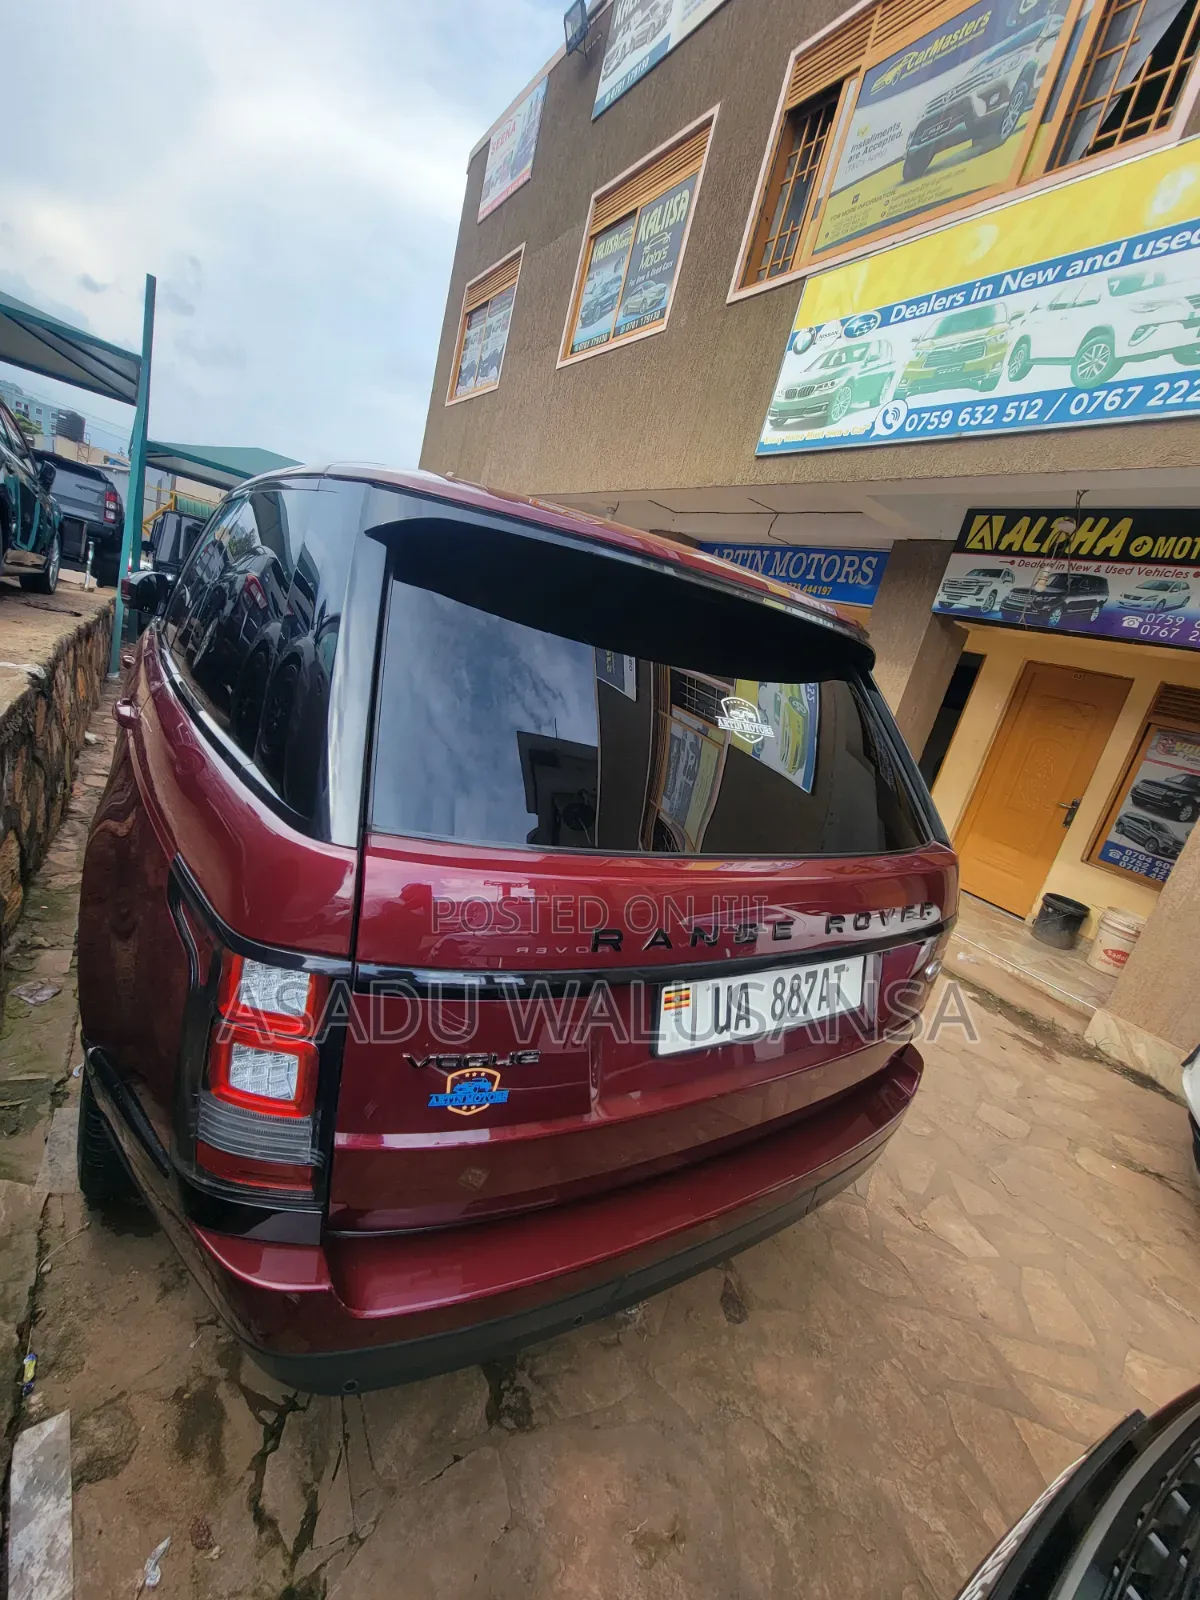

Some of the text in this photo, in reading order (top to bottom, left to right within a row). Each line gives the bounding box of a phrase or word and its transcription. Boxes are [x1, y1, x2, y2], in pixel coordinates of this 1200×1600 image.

[905, 10, 993, 71] CarMasters
[851, 122, 901, 153] Installments
[848, 151, 861, 164] are
[637, 189, 690, 245] KALIISA
[639, 246, 670, 272] Motors
[889, 289, 965, 324] Dealers
[970, 282, 994, 302] in
[1000, 265, 1063, 295] New
[1066, 241, 1126, 278] and
[905, 410, 953, 433] 0759
[956, 404, 998, 429] 632
[1002, 398, 1044, 424] 512
[1069, 385, 1145, 416] 0767
[998, 515, 1134, 558] ALPHA
[768, 551, 878, 587] MOTORS
[1055, 561, 1066, 571] in
[1068, 562, 1091, 573] New
[1093, 564, 1102, 574] &
[1104, 564, 1135, 576] Used
[1136, 566, 1190, 579] Vehicles
[803, 584, 833, 597] 444197
[1145, 612, 1185, 627] 0759
[1140, 624, 1181, 639] 0767
[1121, 855, 1150, 870] 0752
[1124, 849, 1153, 864] 0704
[1118, 861, 1147, 876] 0702
[590, 901, 936, 954] RANGE ROVER
[713, 963, 847, 1036] UA 887AT
[401, 1050, 542, 1069] VOGUE
[429, 1091, 509, 1107] ARTIN MOTORS
